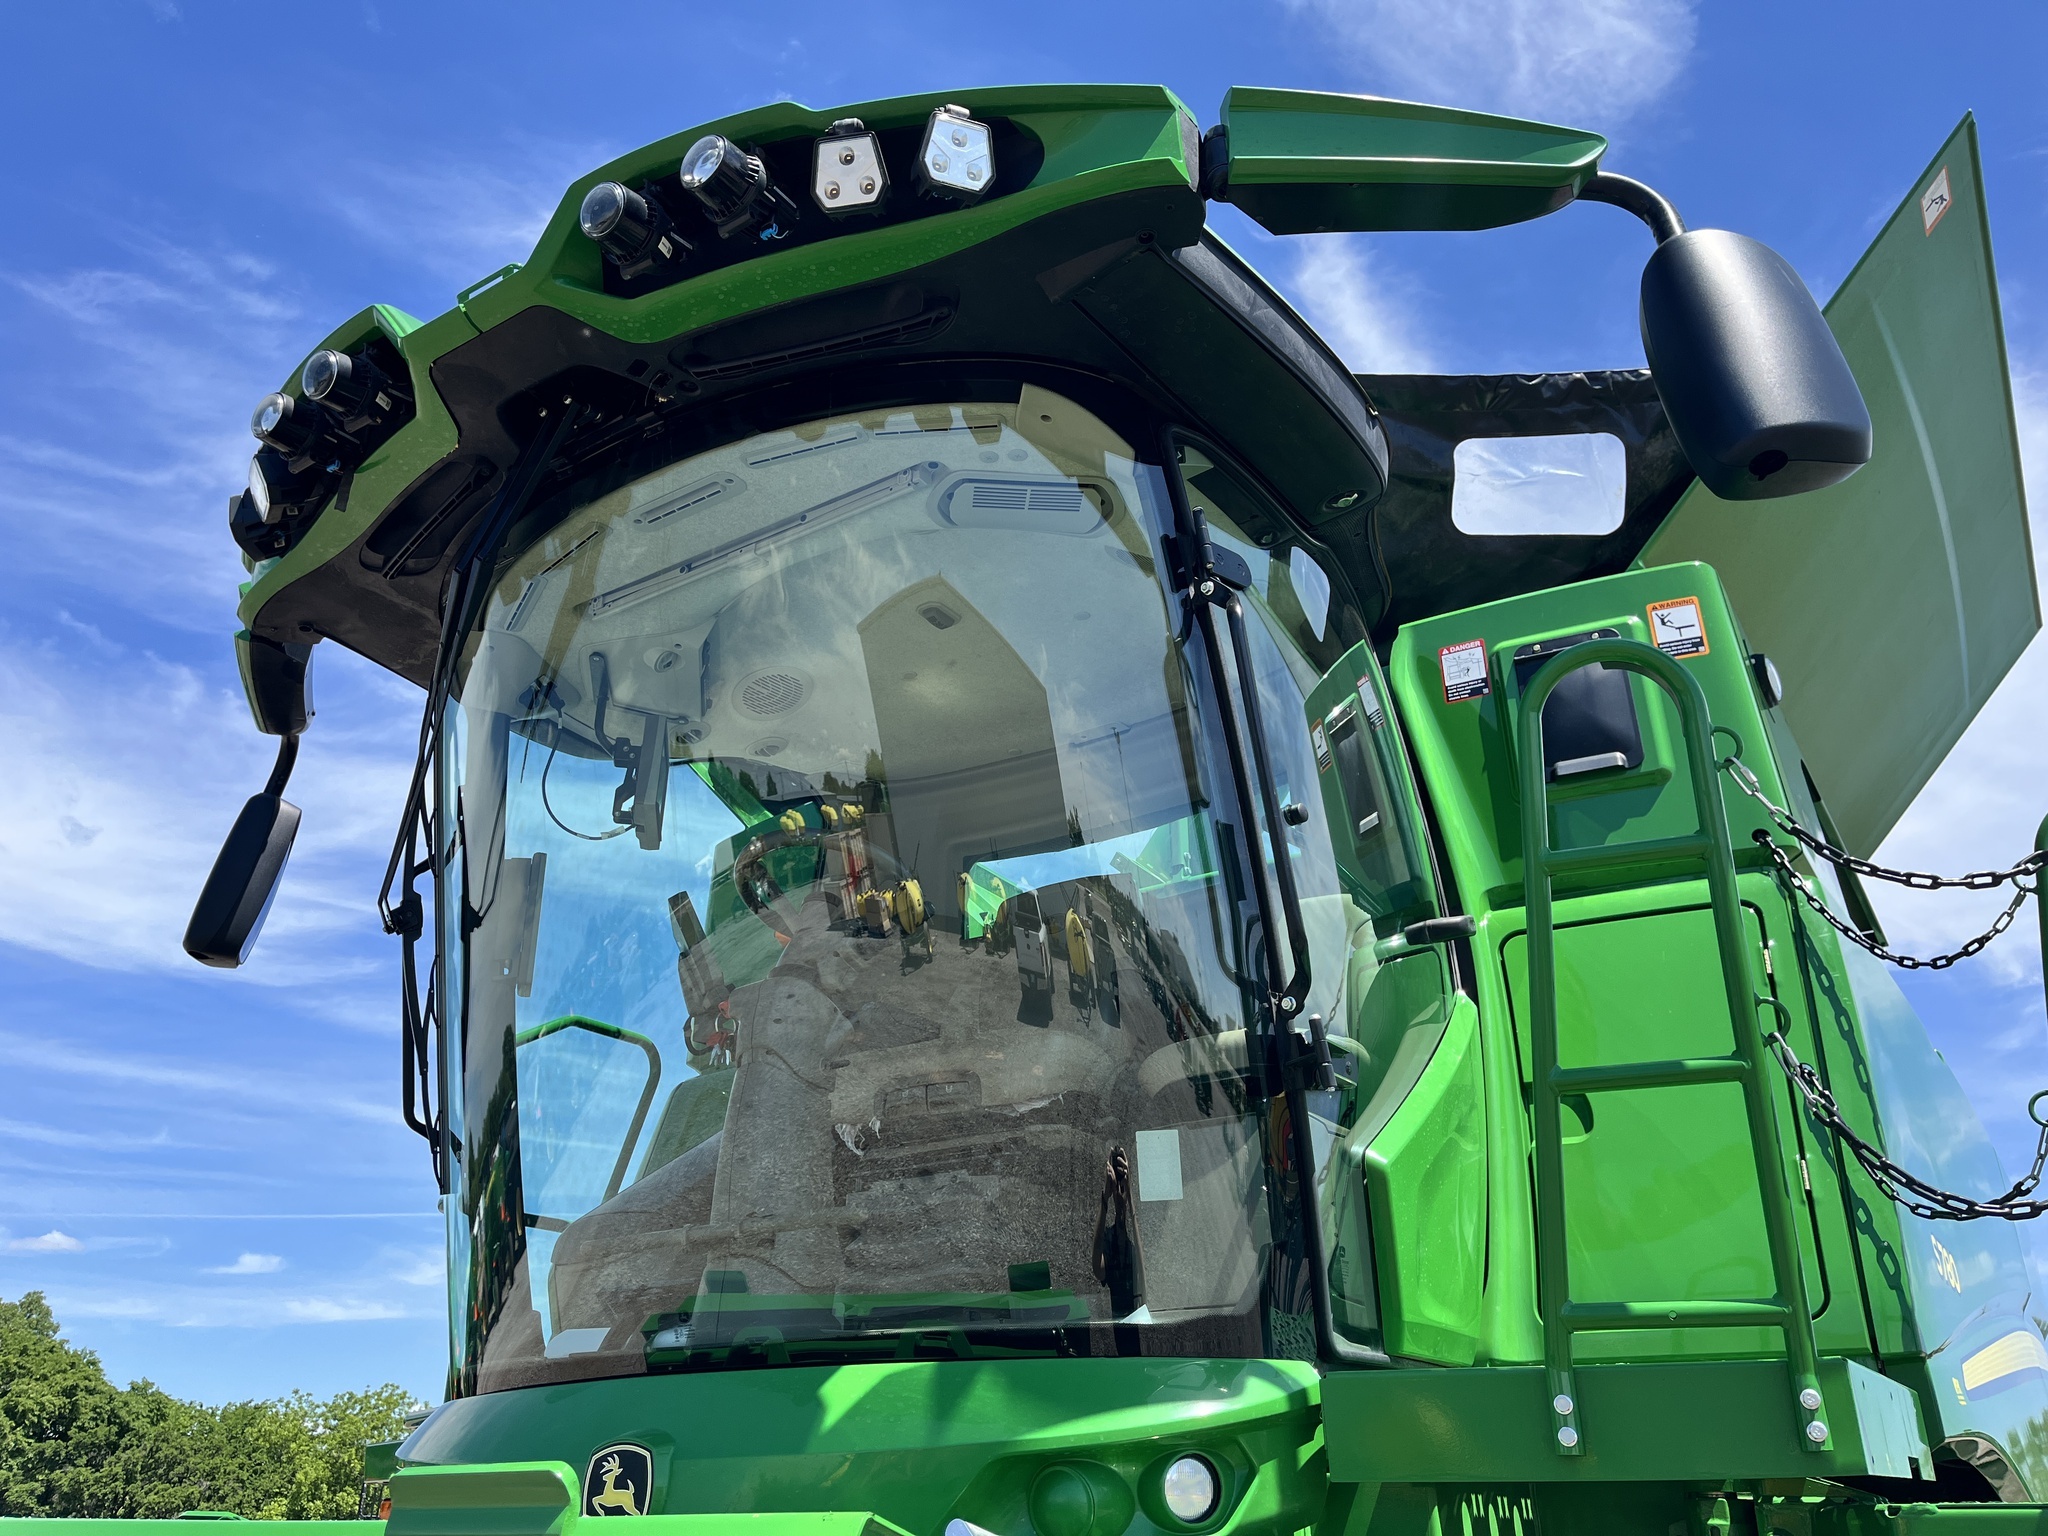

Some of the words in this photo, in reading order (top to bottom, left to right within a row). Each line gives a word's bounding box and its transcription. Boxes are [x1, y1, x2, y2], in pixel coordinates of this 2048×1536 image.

[1658, 598, 1694, 609] WARNING
[1449, 641, 1481, 653] DANGER
[1930, 1233, 1962, 1294] S780
